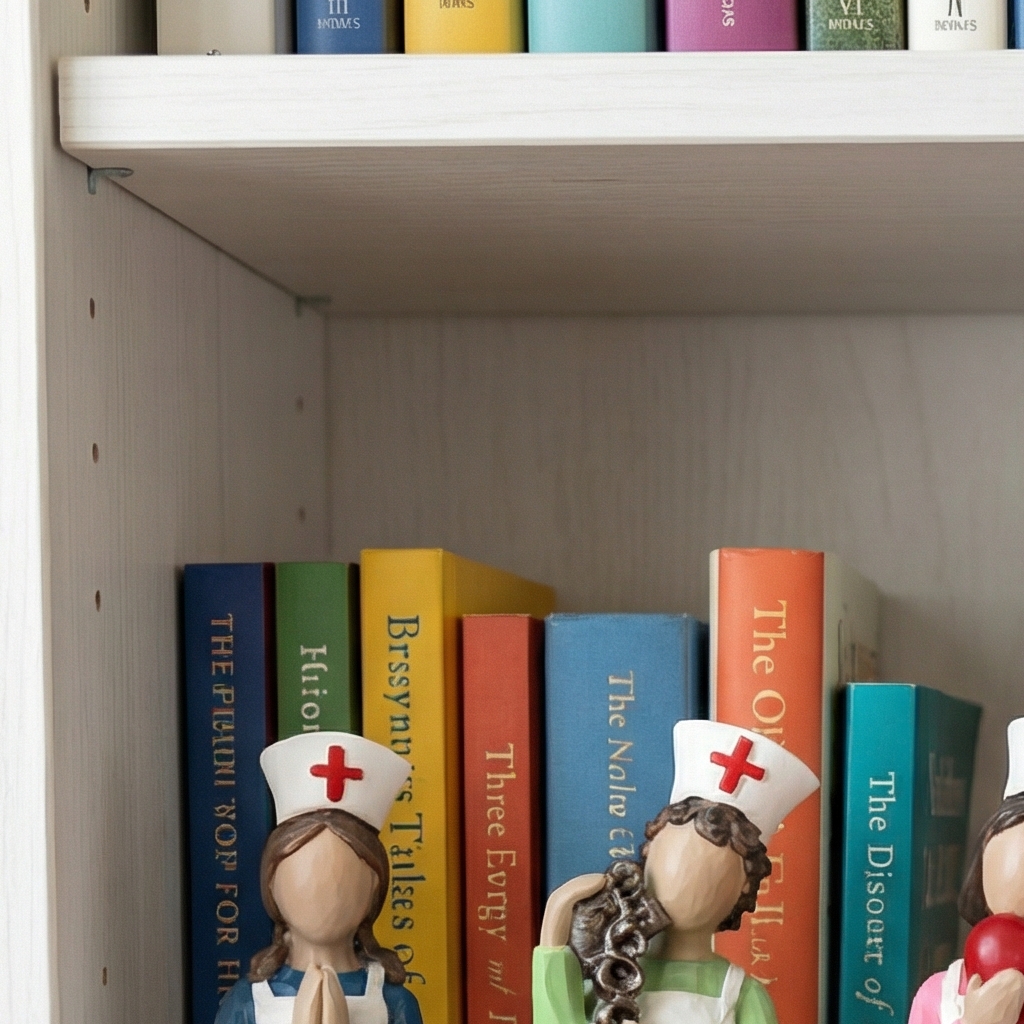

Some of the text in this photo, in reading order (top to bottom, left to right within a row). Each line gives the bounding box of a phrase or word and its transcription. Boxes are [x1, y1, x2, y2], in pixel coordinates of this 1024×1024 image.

[211, 613, 234, 676] THE
[752, 599, 787, 675] The
[608, 670, 636, 727] The
[486, 743, 517, 837] Three
[868, 771, 896, 832] The
[216, 883, 239, 945] FOR
[855, 978, 894, 1016] of
